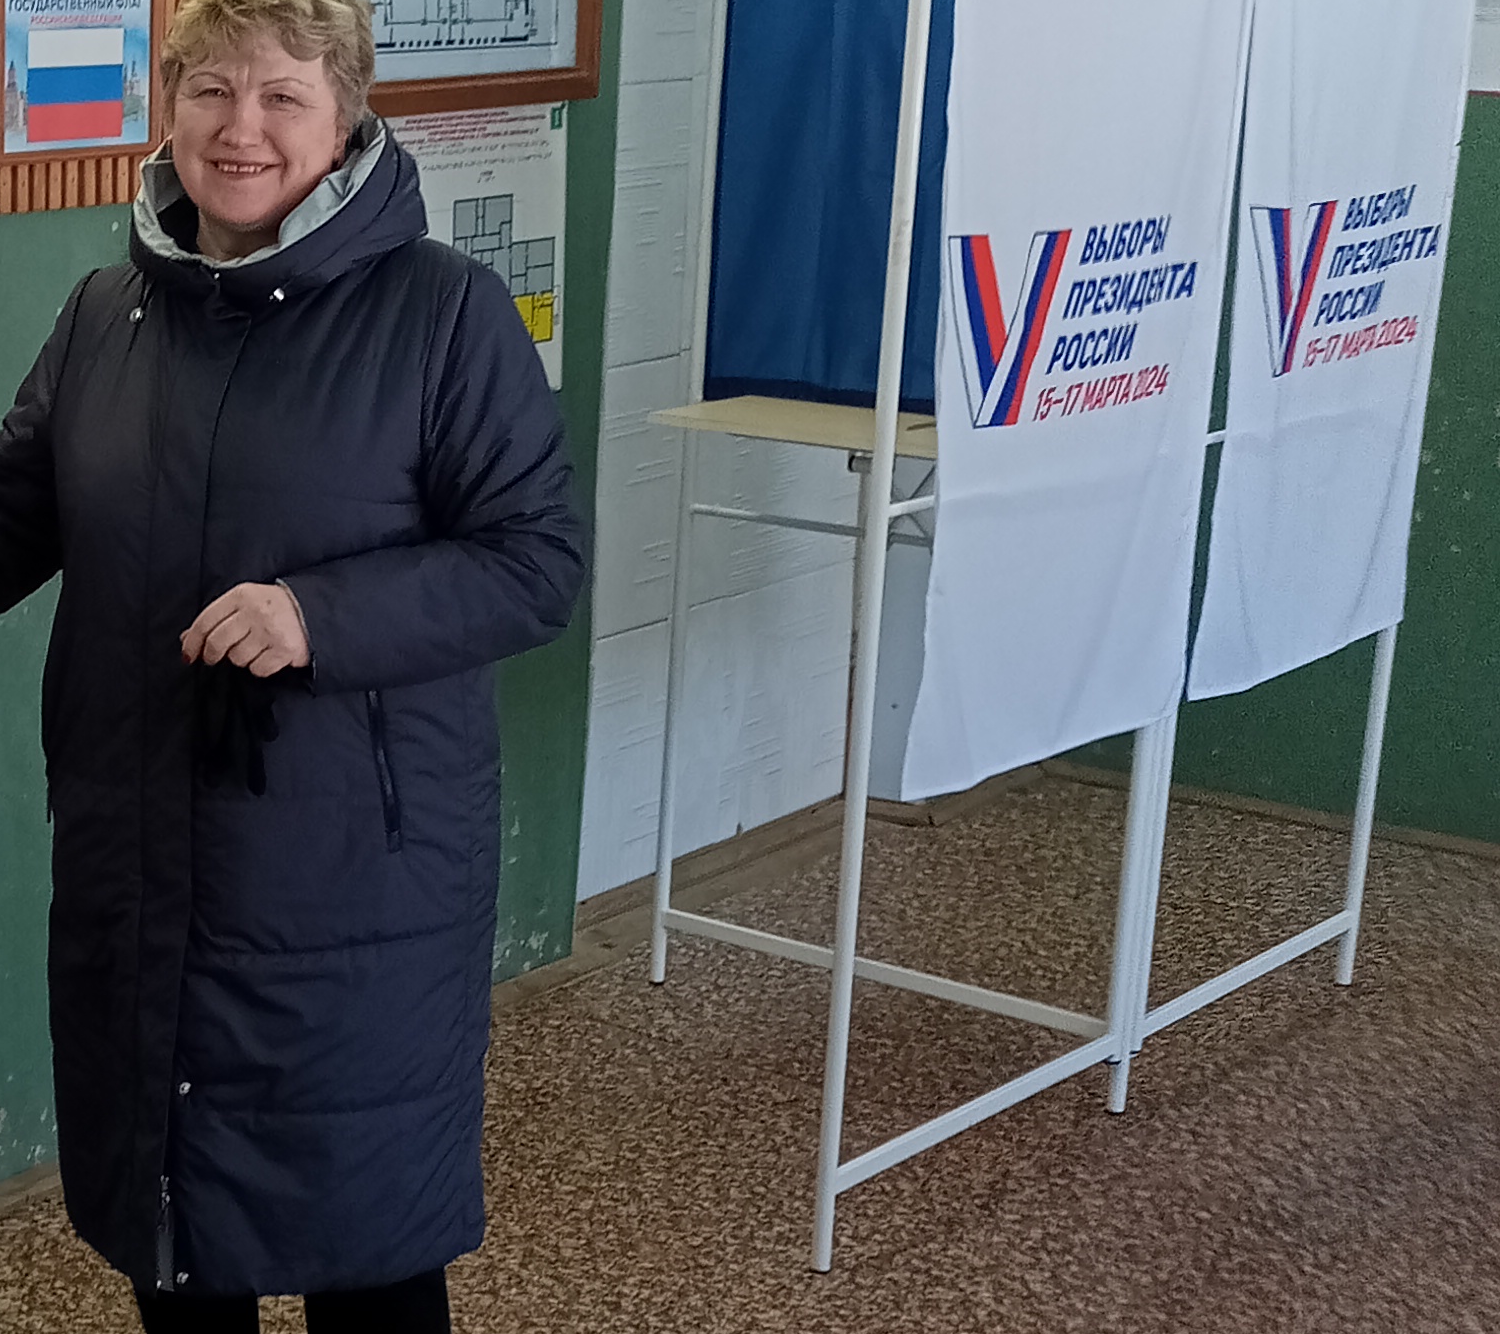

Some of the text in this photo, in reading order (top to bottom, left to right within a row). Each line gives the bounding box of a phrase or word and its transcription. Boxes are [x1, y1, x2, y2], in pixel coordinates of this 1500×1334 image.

[1341, 184, 1417, 232] ВЫБОРЫ
[1079, 214, 1172, 266] ВЫБОРЫ
[1327, 223, 1442, 280] ПРЕЗИДЕНТА
[1062, 260, 1198, 321] ПРЕЗИДЕНТА
[1313, 280, 1385, 327] РОССИИ
[1045, 320, 1140, 375] РОССИИ
[1374, 315, 1418, 348] 2024
[1079, 370, 1134, 413] МАРТА
[1132, 363, 1170, 401] 2024
